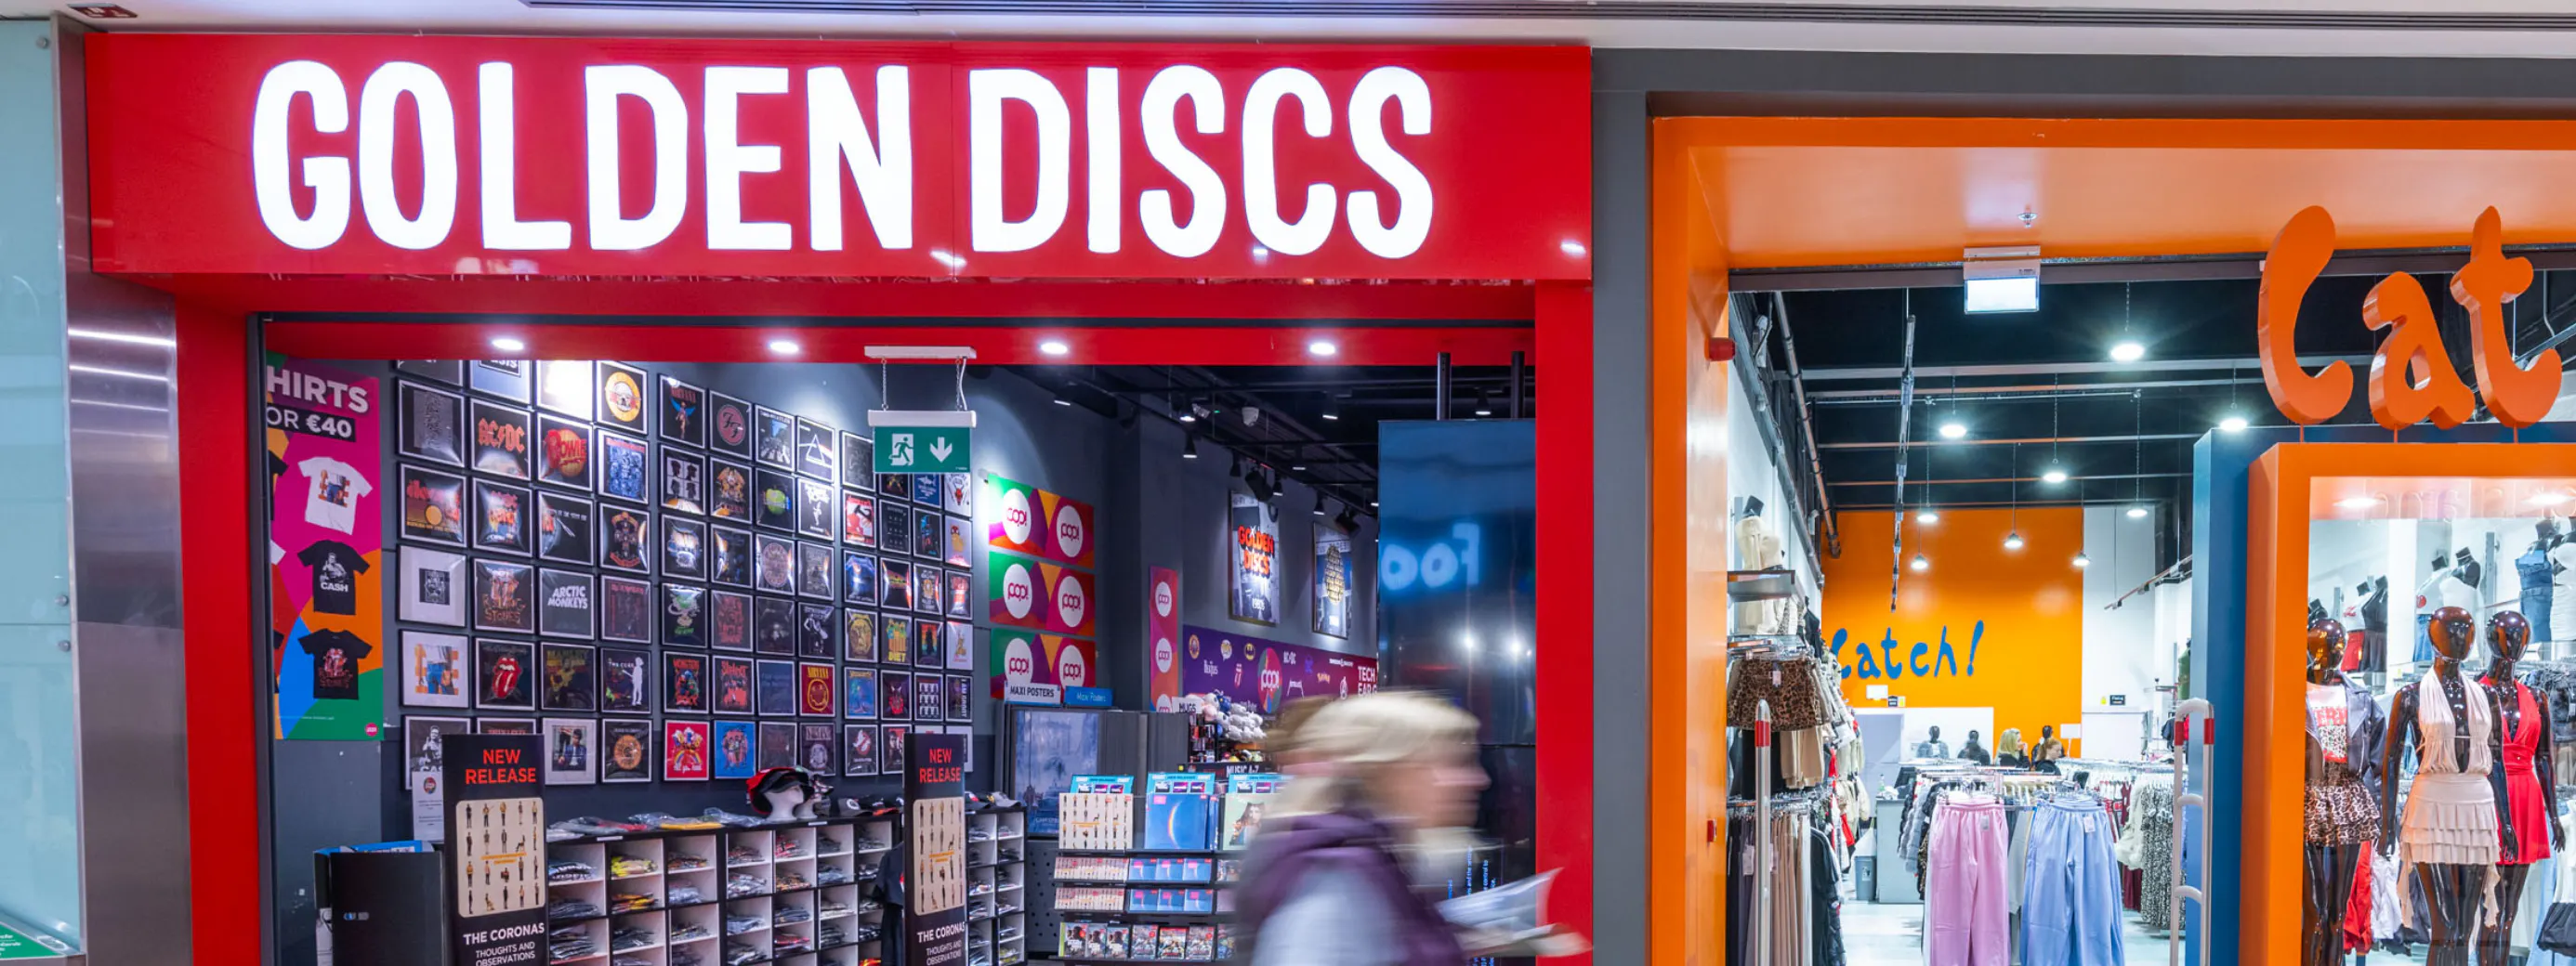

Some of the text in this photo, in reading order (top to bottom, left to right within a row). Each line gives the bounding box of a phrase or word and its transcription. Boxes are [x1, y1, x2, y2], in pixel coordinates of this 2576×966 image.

[252, 60, 1433, 259] GOLDEN DISCS
[2258, 205, 2562, 429] Cat
[306, 414, 352, 438] €40
[478, 417, 525, 453] AC/DC
[544, 428, 587, 469] BOWIE
[1238, 525, 1275, 555] GOLDEN
[1243, 549, 1270, 576] DISCS
[320, 581, 348, 593] CASH
[552, 585, 586, 597] ARCTIC
[547, 597, 588, 609] MONKEYS
[1831, 620, 1984, 680] Catch!
[1260, 669, 1280, 692] pop!
[1358, 666, 1375, 683] TECH
[1009, 685, 1055, 698] MAXI POSTERS
[1178, 702, 1197, 713] MUGS
[483, 749, 521, 764] NEW
[929, 748, 953, 764] NEW
[466, 768, 536, 784] RELEASE
[919, 767, 961, 784] RELEASE
[1227, 764, 1247, 776] MUSIC
[463, 922, 545, 946] THE CORONAS
[916, 929, 935, 943] THE
[475, 941, 535, 959] THOUGHTS AND
[926, 942, 953, 956] THOUGHTS
[475, 950, 536, 966] OBSERVATIONS
